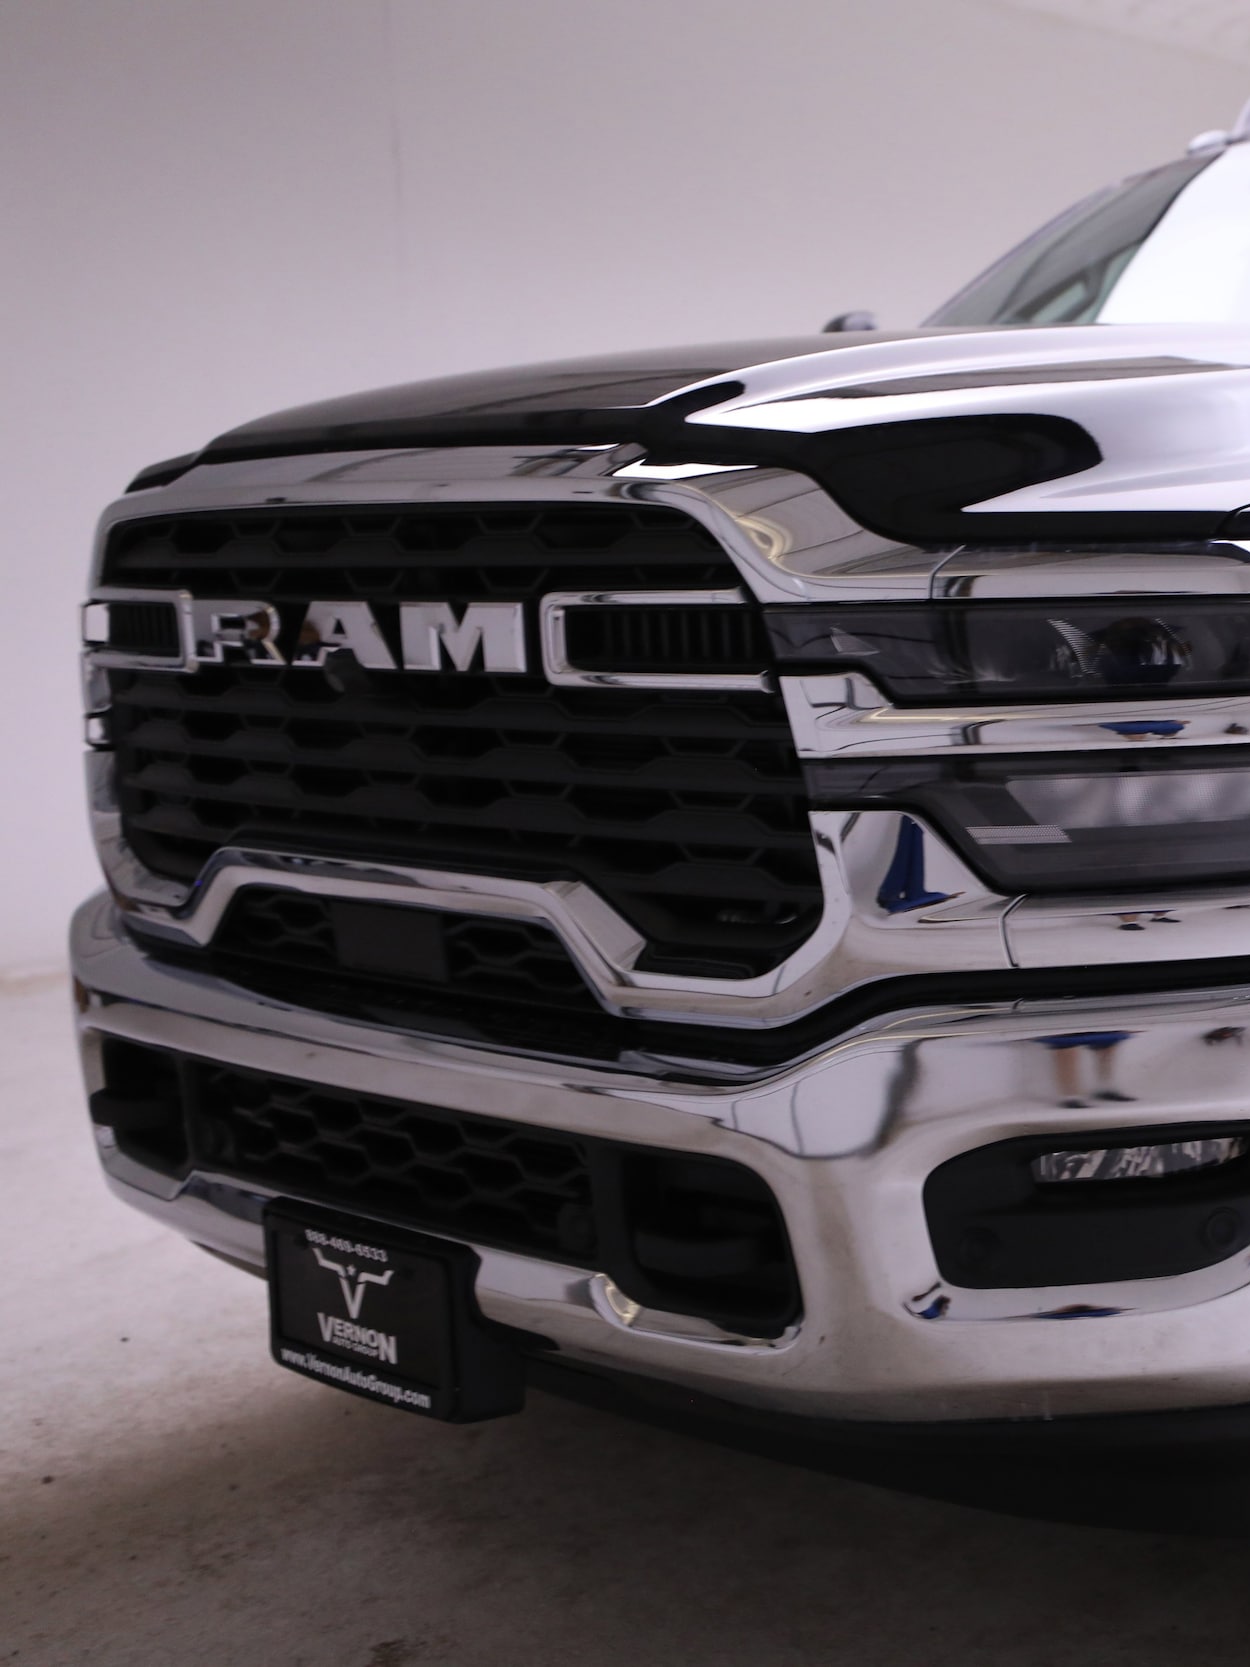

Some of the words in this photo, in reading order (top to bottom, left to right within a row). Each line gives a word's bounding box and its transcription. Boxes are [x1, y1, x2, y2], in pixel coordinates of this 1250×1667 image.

[195, 599, 527, 673] RAM
[317, 1312, 398, 1365] VERNON
[281, 1348, 431, 1409] www.VernonAutoGroup.com
